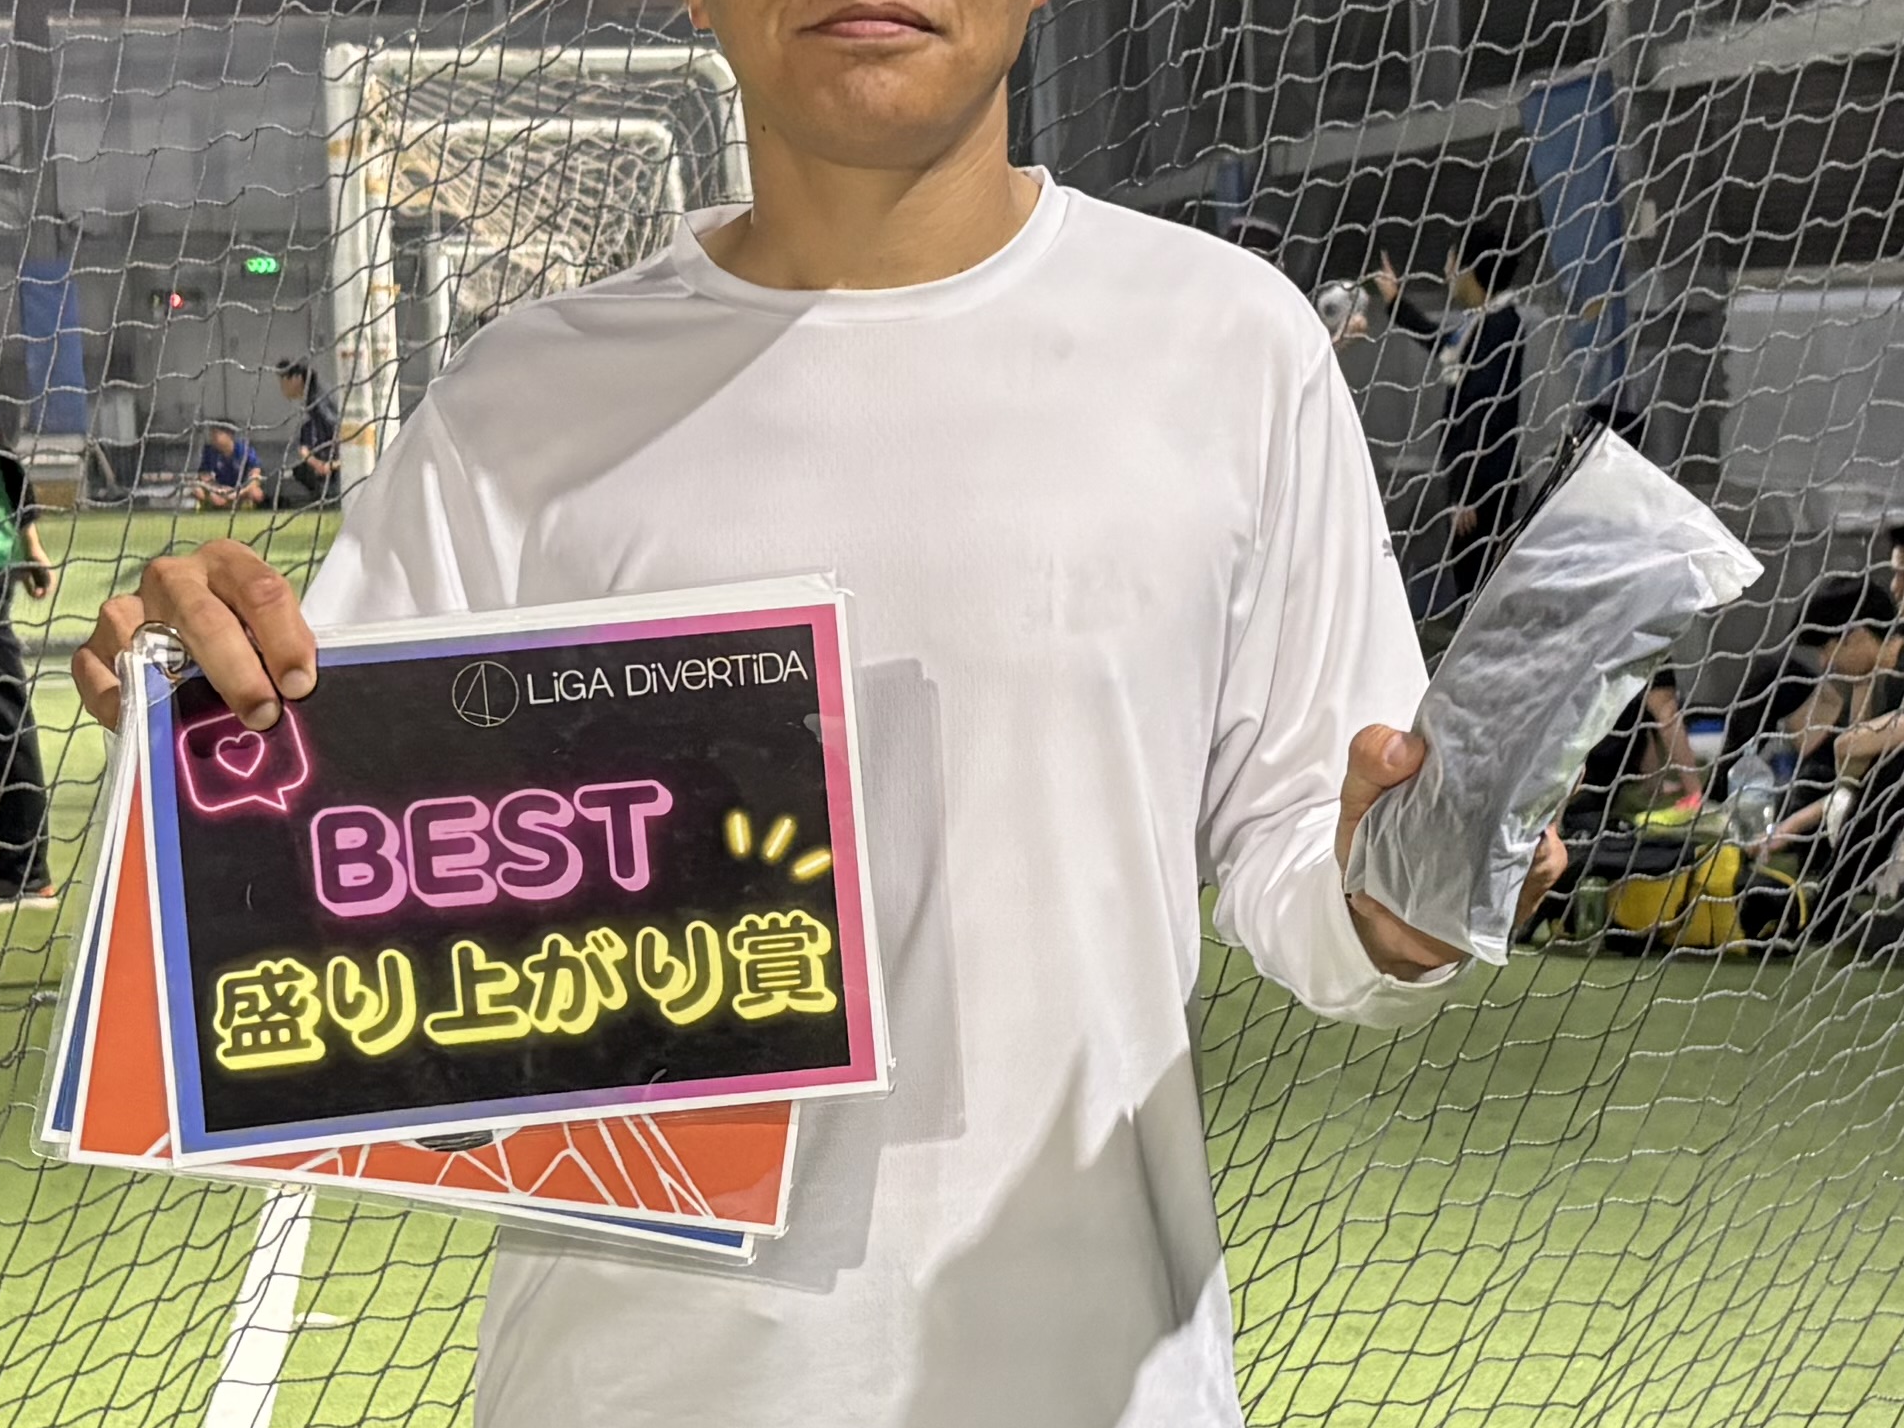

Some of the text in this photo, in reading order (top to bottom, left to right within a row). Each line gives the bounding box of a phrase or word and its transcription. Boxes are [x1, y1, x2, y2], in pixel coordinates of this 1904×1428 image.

[311, 780, 673, 917] BEST
[215, 911, 839, 1071] 盛り上がり賞
